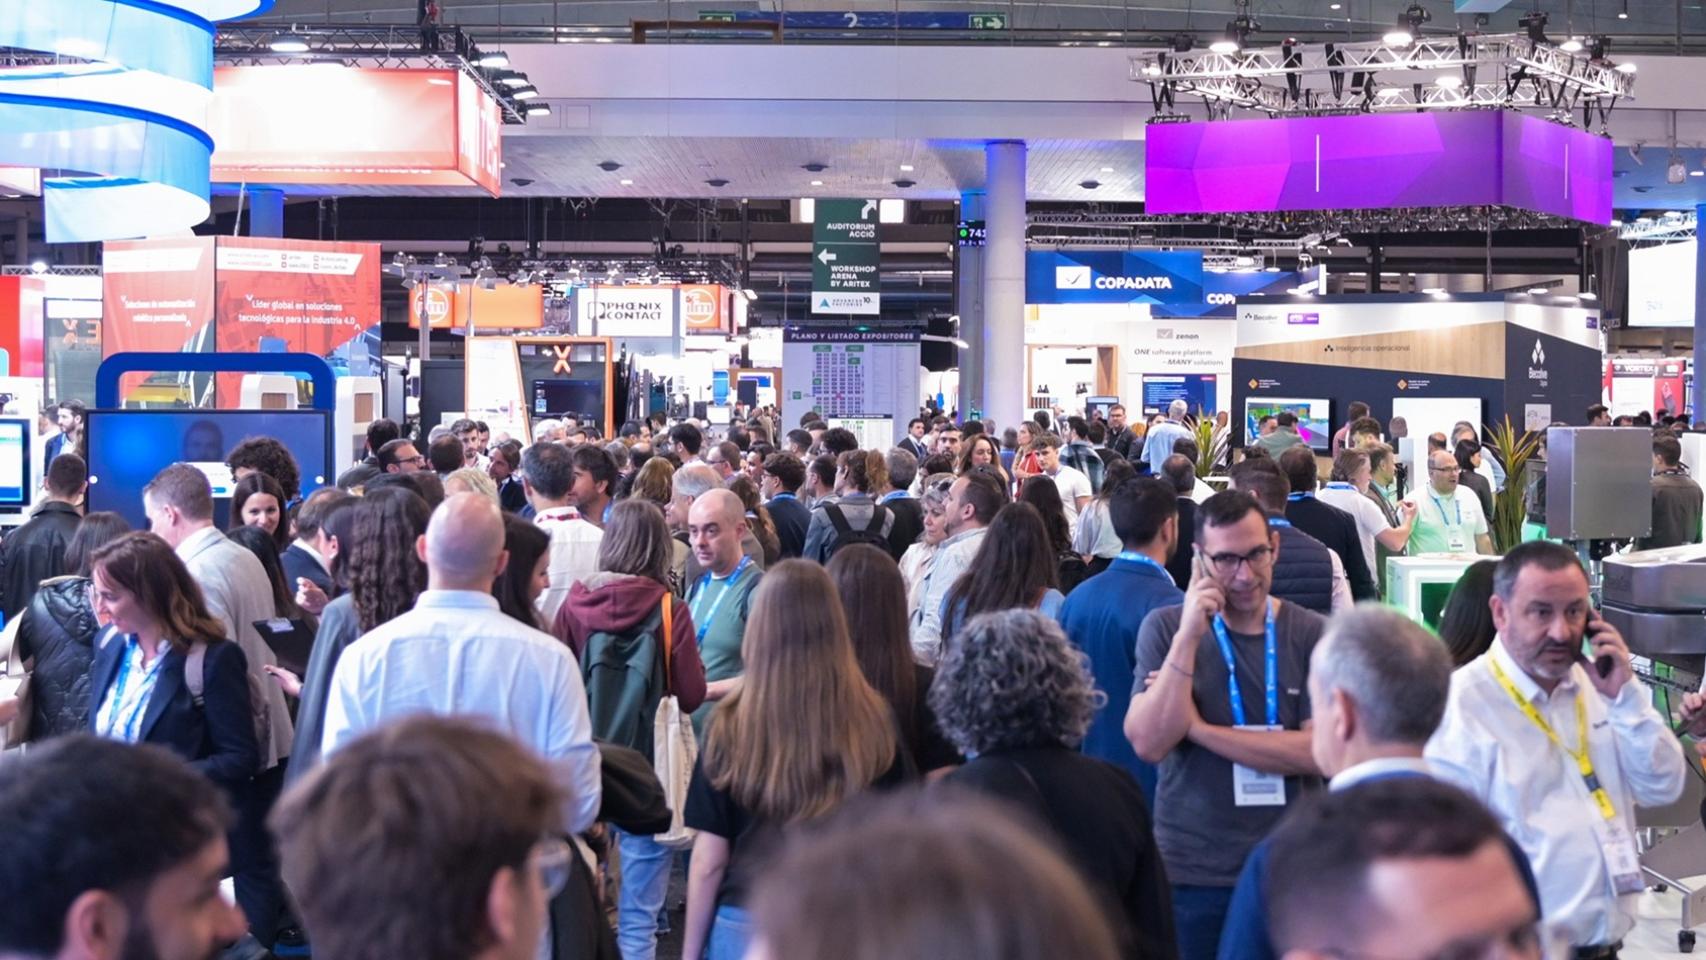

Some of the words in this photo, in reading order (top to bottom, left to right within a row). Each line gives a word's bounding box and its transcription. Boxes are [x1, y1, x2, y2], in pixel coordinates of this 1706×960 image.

[827, 223, 876, 231] AUDITORIUM
[831, 265, 876, 273] WORKSHOP
[1095, 277, 1172, 289] COPADATA
[1206, 294, 1236, 305] COP
[252, 300, 271, 309] Líder
[272, 301, 294, 311] global
[306, 303, 342, 311] soluciones
[239, 314, 284, 324] tecnológicas
[286, 316, 301, 324] para
[607, 311, 661, 320] CONTACT
[1182, 348, 1212, 357] platform
